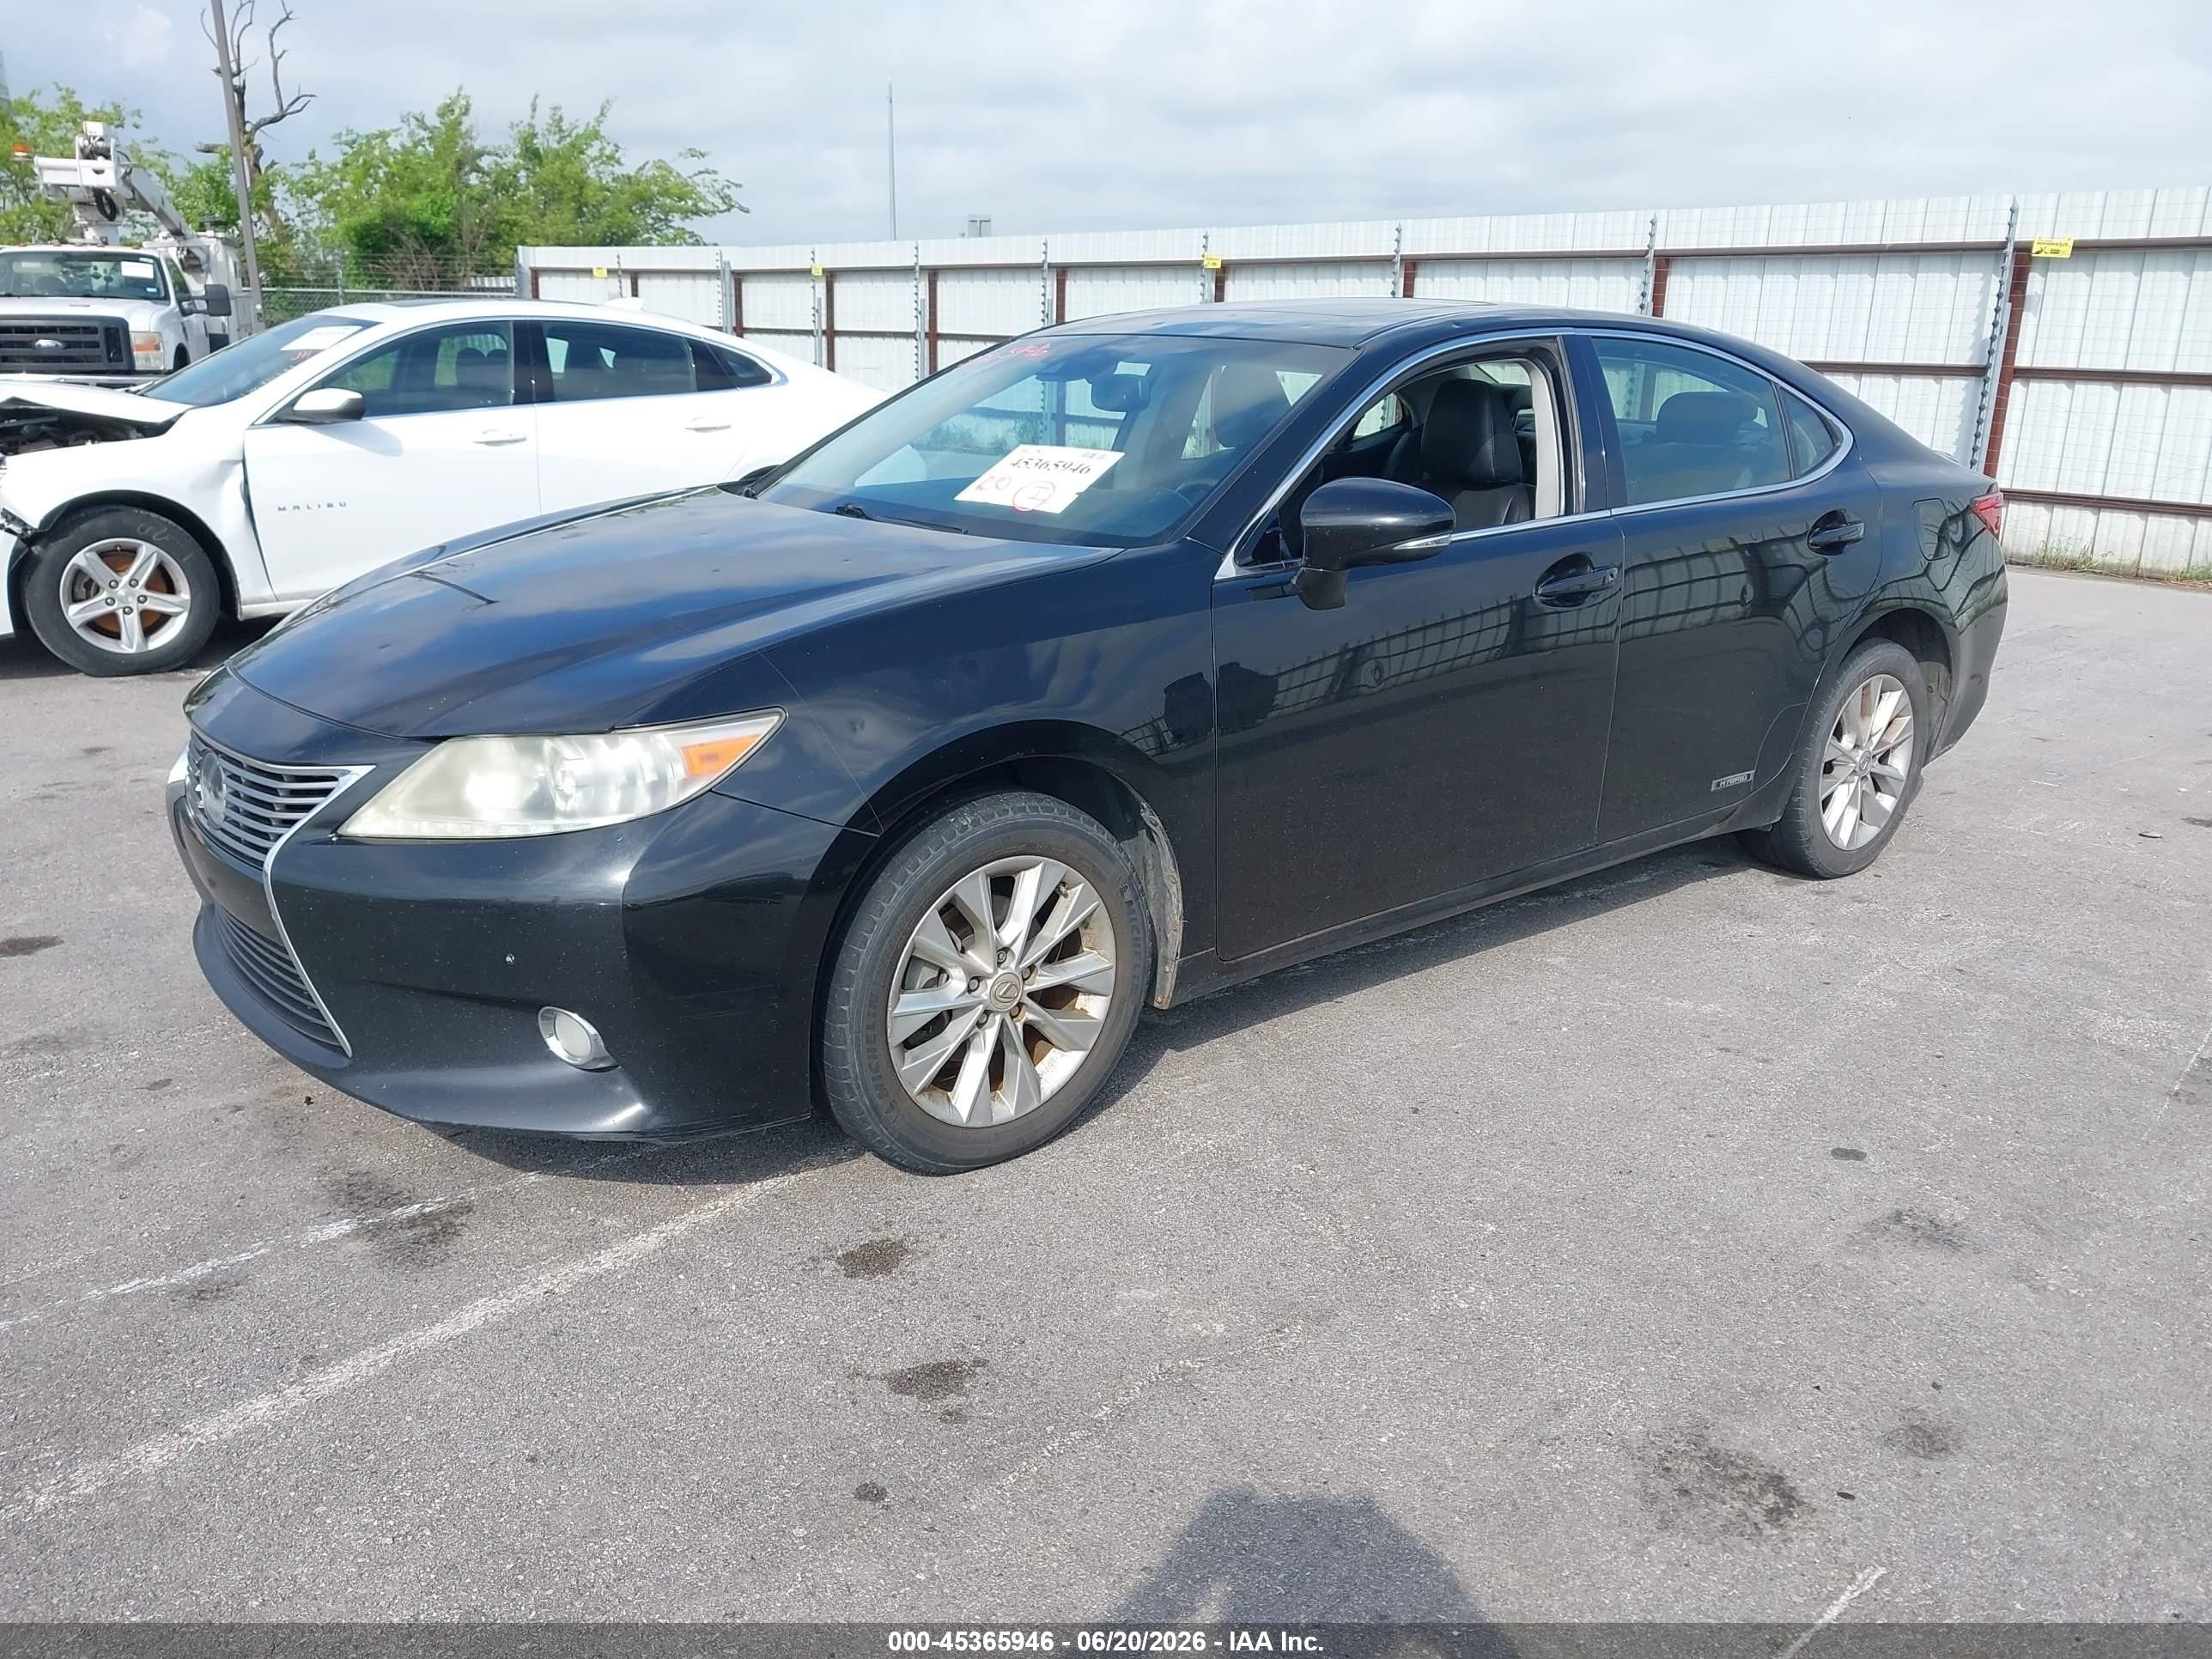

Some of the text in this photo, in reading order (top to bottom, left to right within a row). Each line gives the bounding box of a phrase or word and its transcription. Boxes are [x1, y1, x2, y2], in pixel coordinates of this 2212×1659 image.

[1010, 458, 1091, 474] 45365946
[277, 501, 347, 512] MALIBU
[1718, 774, 1748, 787] HYBRID
